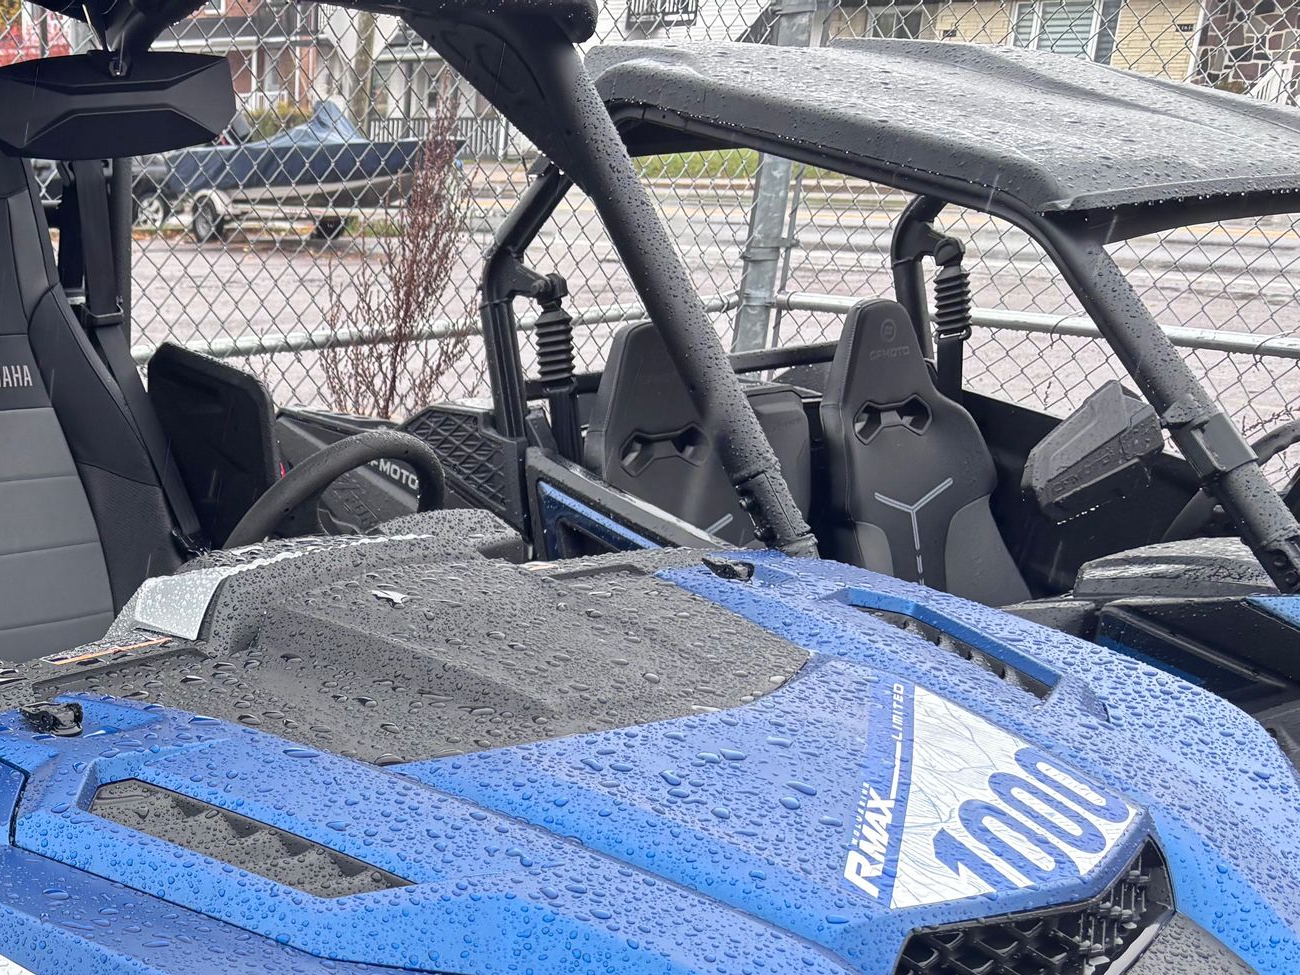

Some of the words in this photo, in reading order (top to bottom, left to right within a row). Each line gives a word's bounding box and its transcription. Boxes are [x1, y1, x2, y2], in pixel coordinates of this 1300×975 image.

[891, 682, 905, 742] LIMITED
[843, 786, 896, 899] RMAX
[932, 746, 1130, 891] 1000
